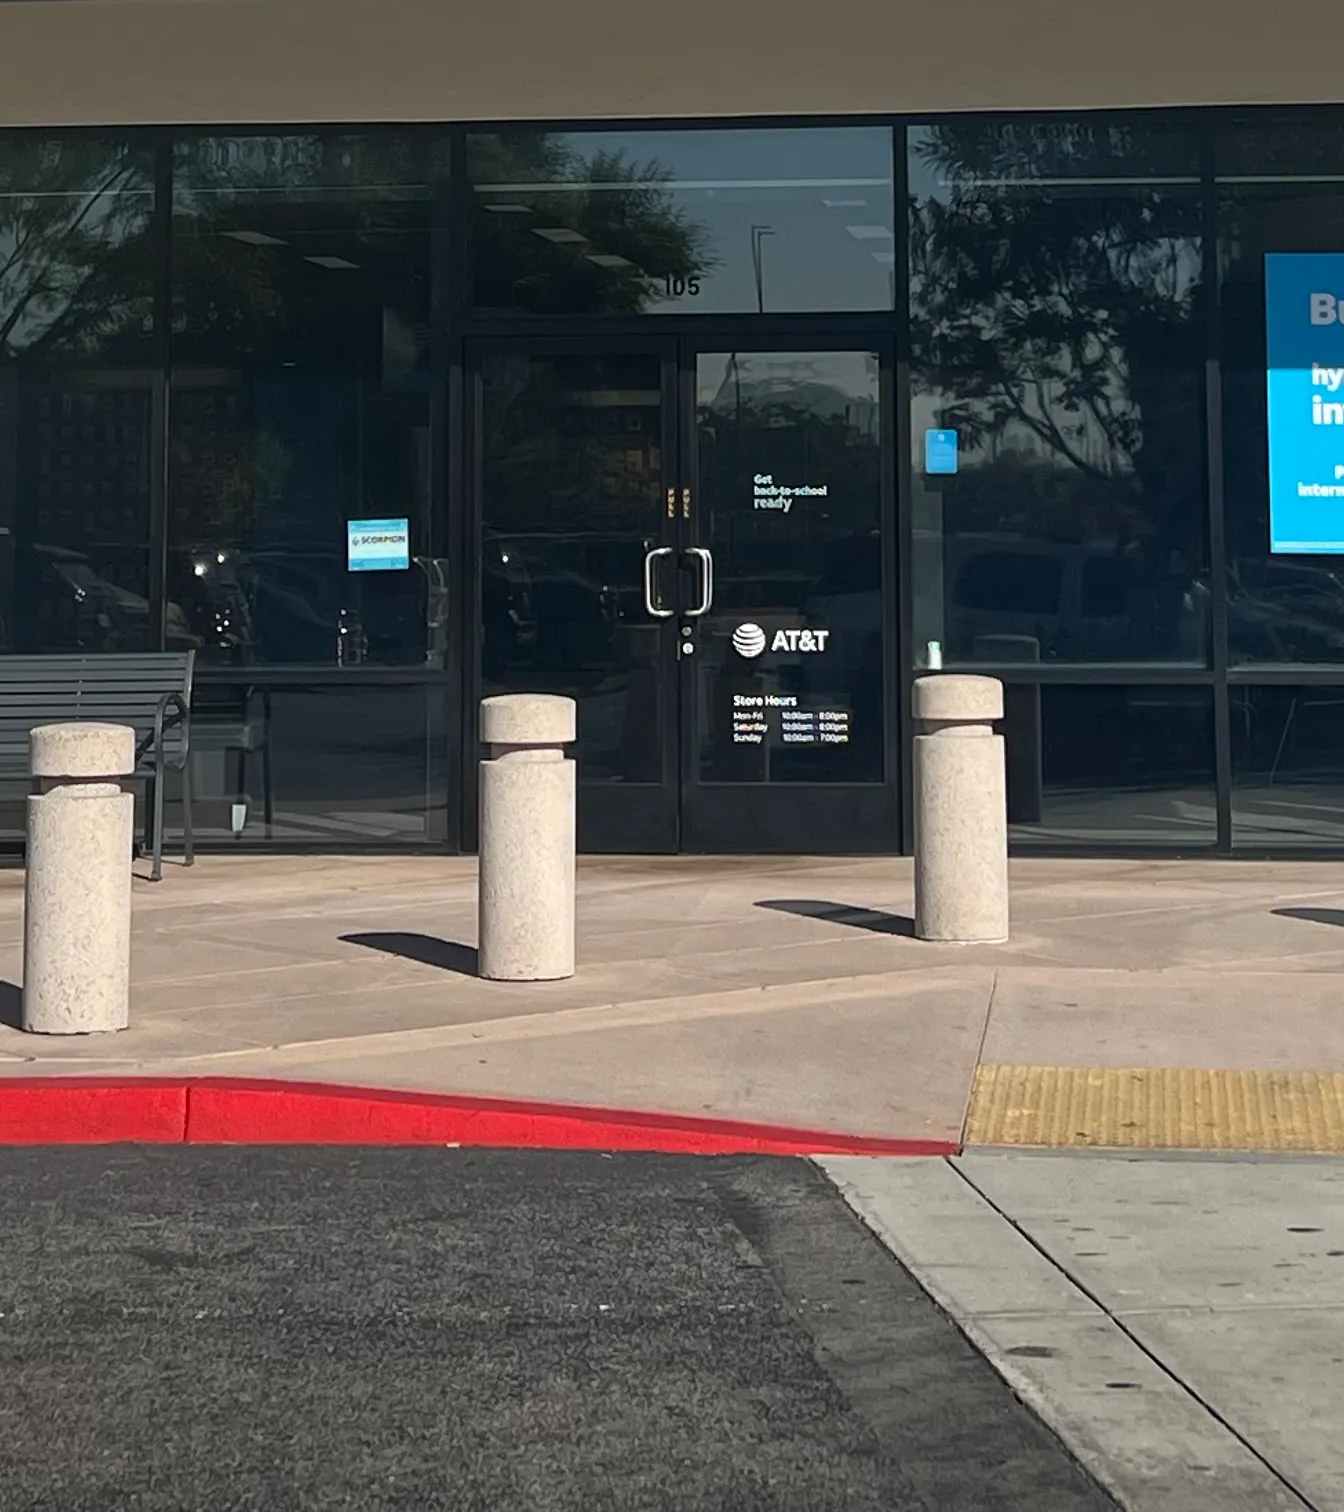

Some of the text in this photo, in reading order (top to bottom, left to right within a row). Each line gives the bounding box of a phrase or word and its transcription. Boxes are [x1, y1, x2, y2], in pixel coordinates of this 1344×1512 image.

[666, 276, 701, 297] 105
[753, 473, 773, 485] Get
[753, 484, 829, 496] back-to-school
[753, 495, 793, 513] ready
[770, 629, 830, 653] AT&T
[733, 694, 798, 707] Store Hours
